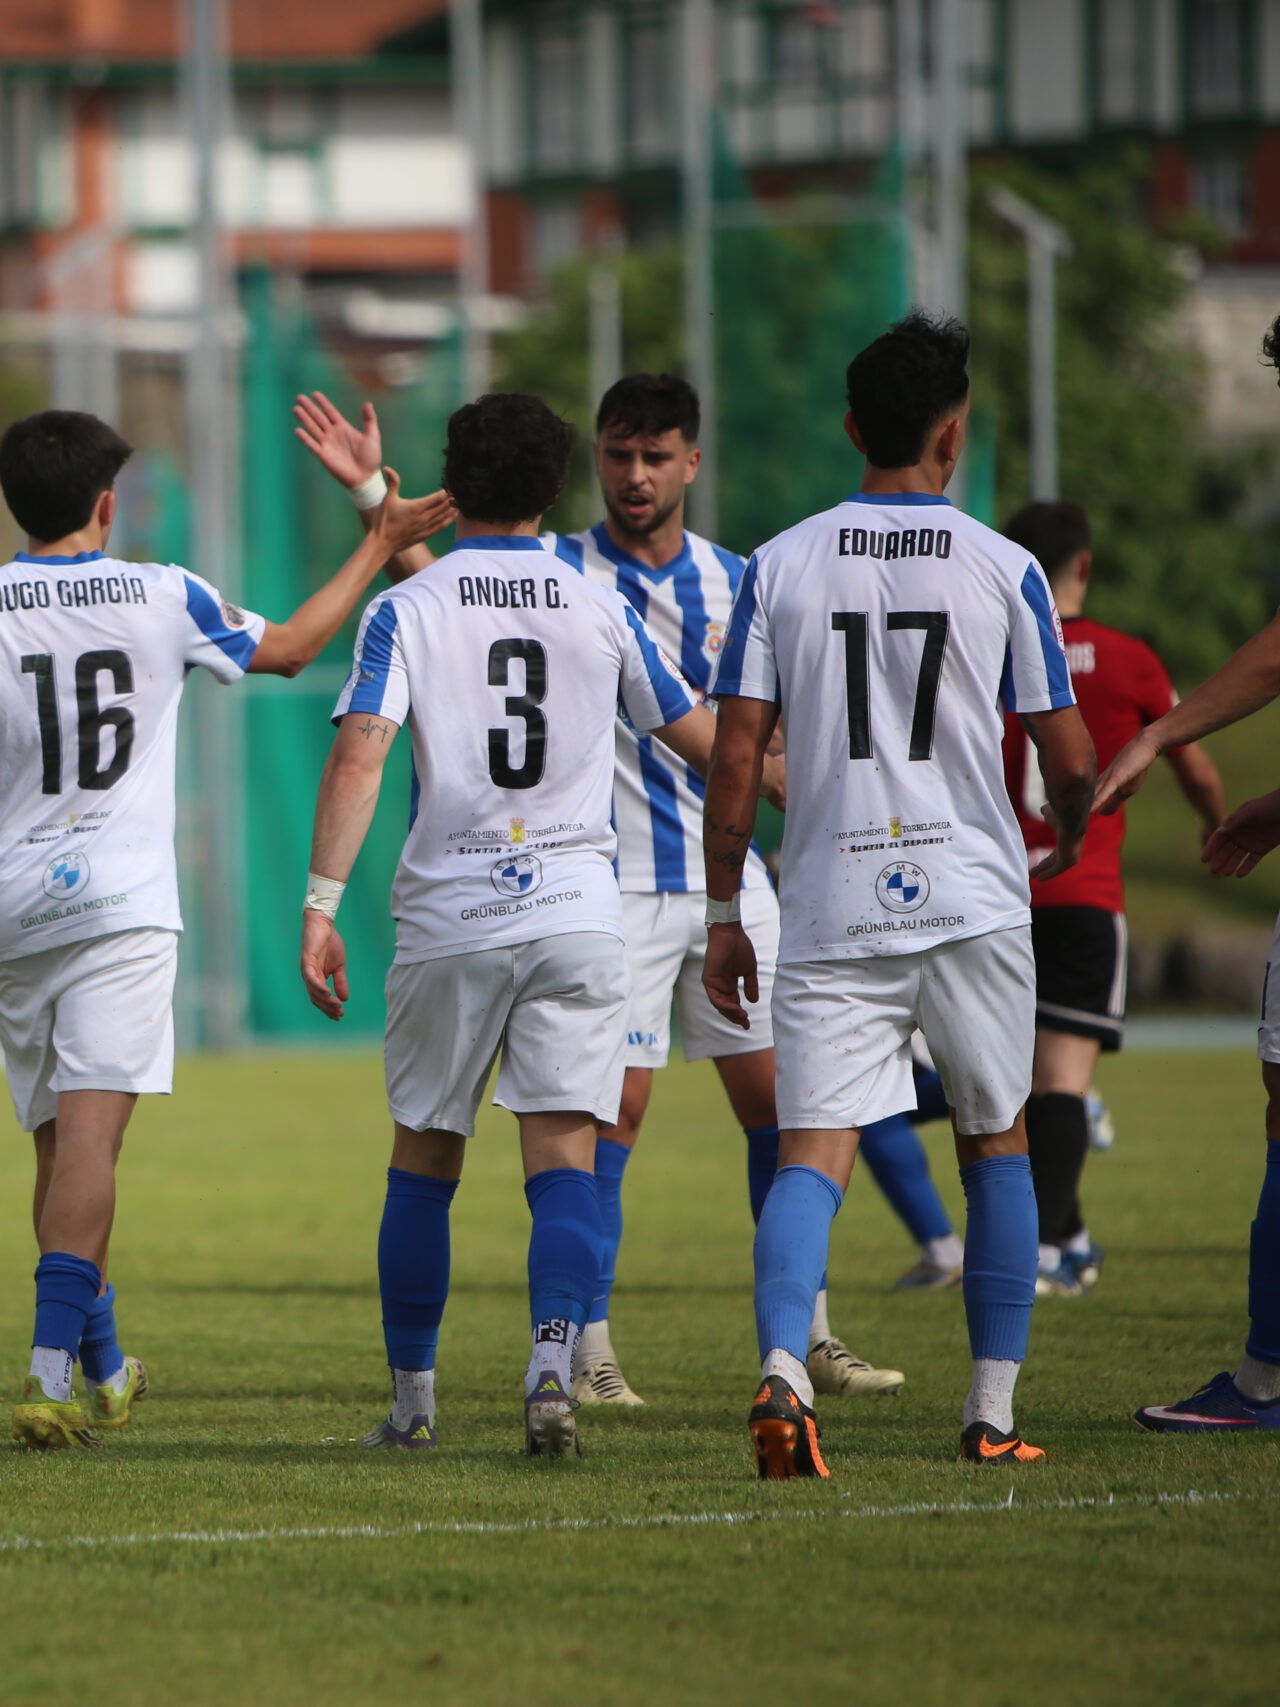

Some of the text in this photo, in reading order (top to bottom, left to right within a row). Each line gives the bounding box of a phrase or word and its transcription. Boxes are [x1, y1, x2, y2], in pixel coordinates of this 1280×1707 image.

[839, 528, 952, 560] EDUARDO
[57, 572, 147, 608] GARCÍA
[458, 575, 568, 609] ANDER G.
[831, 611, 950, 761] 17
[21, 649, 135, 795] 16
[487, 638, 548, 790] 3
[447, 822, 586, 842] AYUNTAMIENTO TORRELAVEGA
[837, 821, 952, 841] AYUNTAMIENTO TORRELAVEGA
[882, 863, 921, 880] BMW
[83, 893, 129, 912] MOTOR
[460, 890, 583, 921] GRÜNBLAU MOTOR
[846, 915, 965, 936] GRÜNBLAU MOTOR
